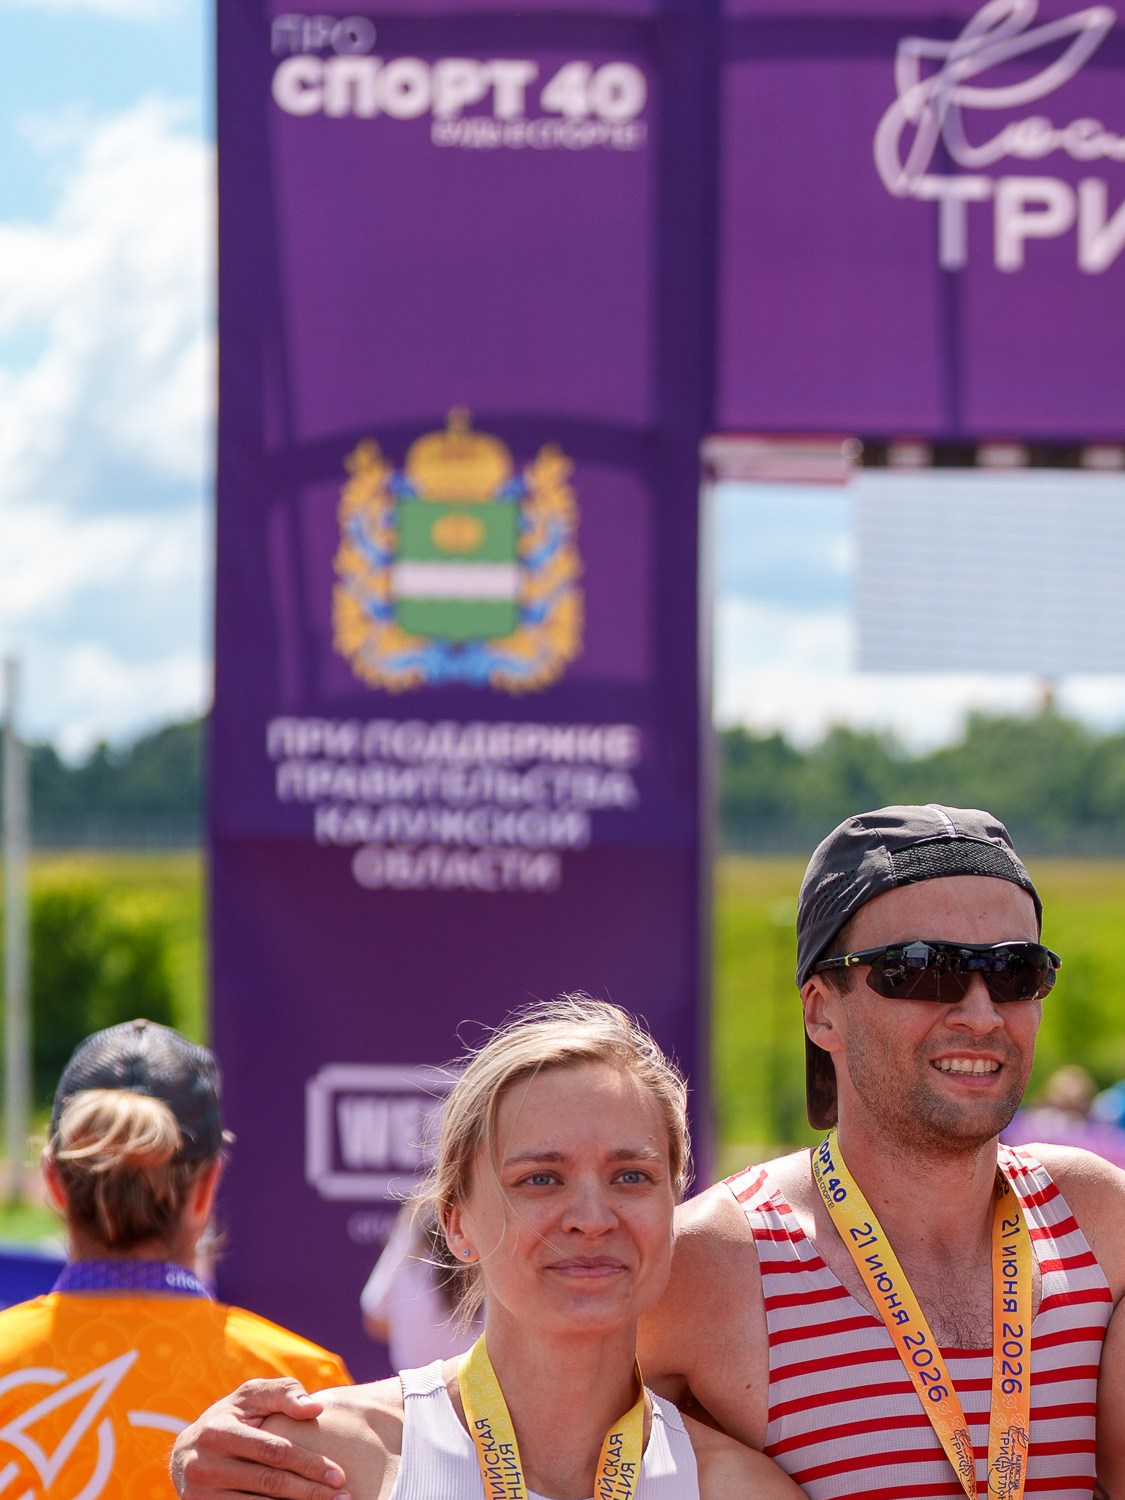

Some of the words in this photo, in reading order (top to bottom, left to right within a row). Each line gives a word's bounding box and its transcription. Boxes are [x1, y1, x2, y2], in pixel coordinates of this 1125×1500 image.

[271, 55, 540, 120] СПОРТ
[539, 60, 648, 120] 40
[828, 1178, 847, 1203] 40
[1001, 1213, 1020, 1239] 21
[1000, 1244, 1018, 1313] ИЮНЯ
[850, 1222, 878, 1249] 21
[864, 1253, 911, 1326] ИЮНЯ
[902, 1330, 949, 1404] 2026
[1000, 1324, 1024, 1395] 2026
